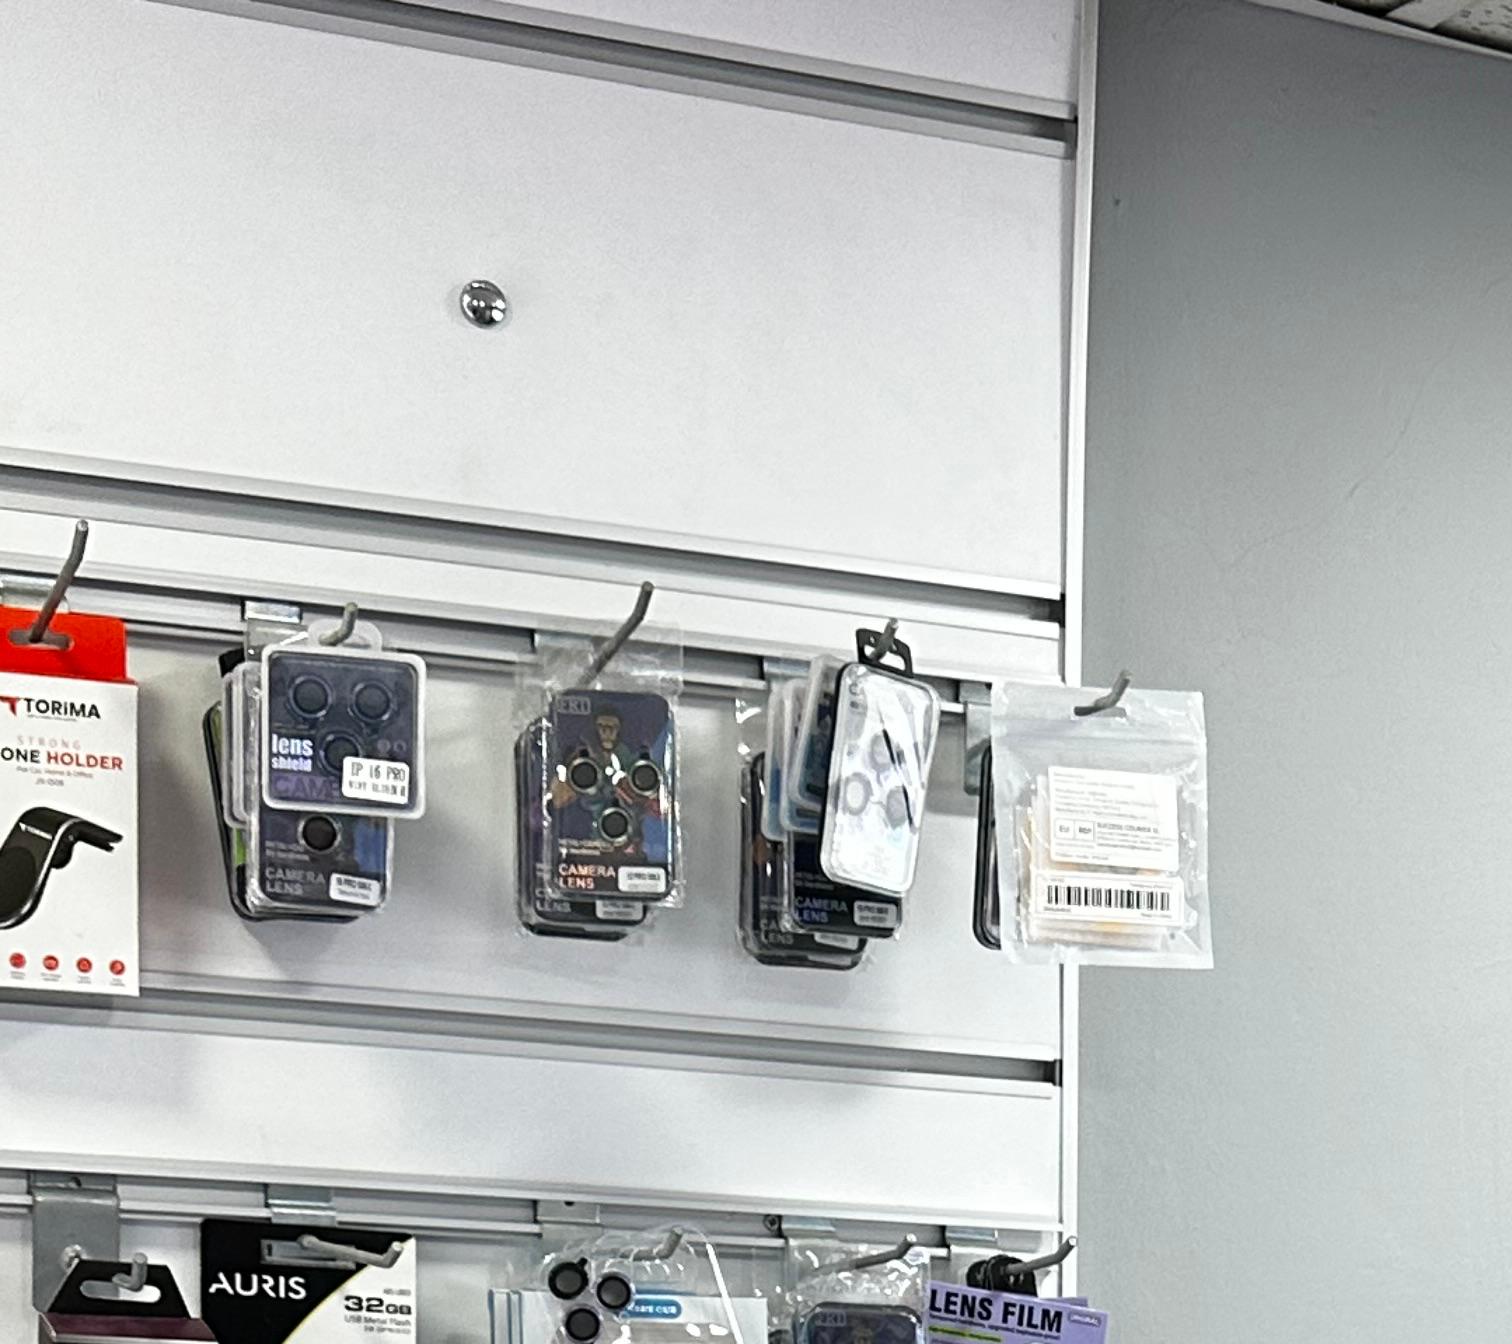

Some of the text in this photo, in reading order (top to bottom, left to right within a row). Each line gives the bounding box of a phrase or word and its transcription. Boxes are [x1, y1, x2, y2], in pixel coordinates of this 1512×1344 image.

[17, 735, 82, 750] STRONG
[271, 733, 314, 756] lens
[46, 751, 124, 771] HOLDER
[271, 756, 313, 773] shield
[369, 764, 381, 779] 16
[387, 767, 406, 782] PRO
[265, 866, 326, 883] CAMERA
[559, 865, 616, 878] CAMERA
[266, 880, 304, 894] LENS
[559, 876, 595, 889] LENS
[795, 897, 849, 911] CAMERA
[795, 909, 829, 923] LENS
[208, 1271, 307, 1300] AURIS
[344, 1295, 412, 1316] 32GB
[929, 1289, 993, 1321] LENS
[1002, 1302, 1063, 1333] FILM
